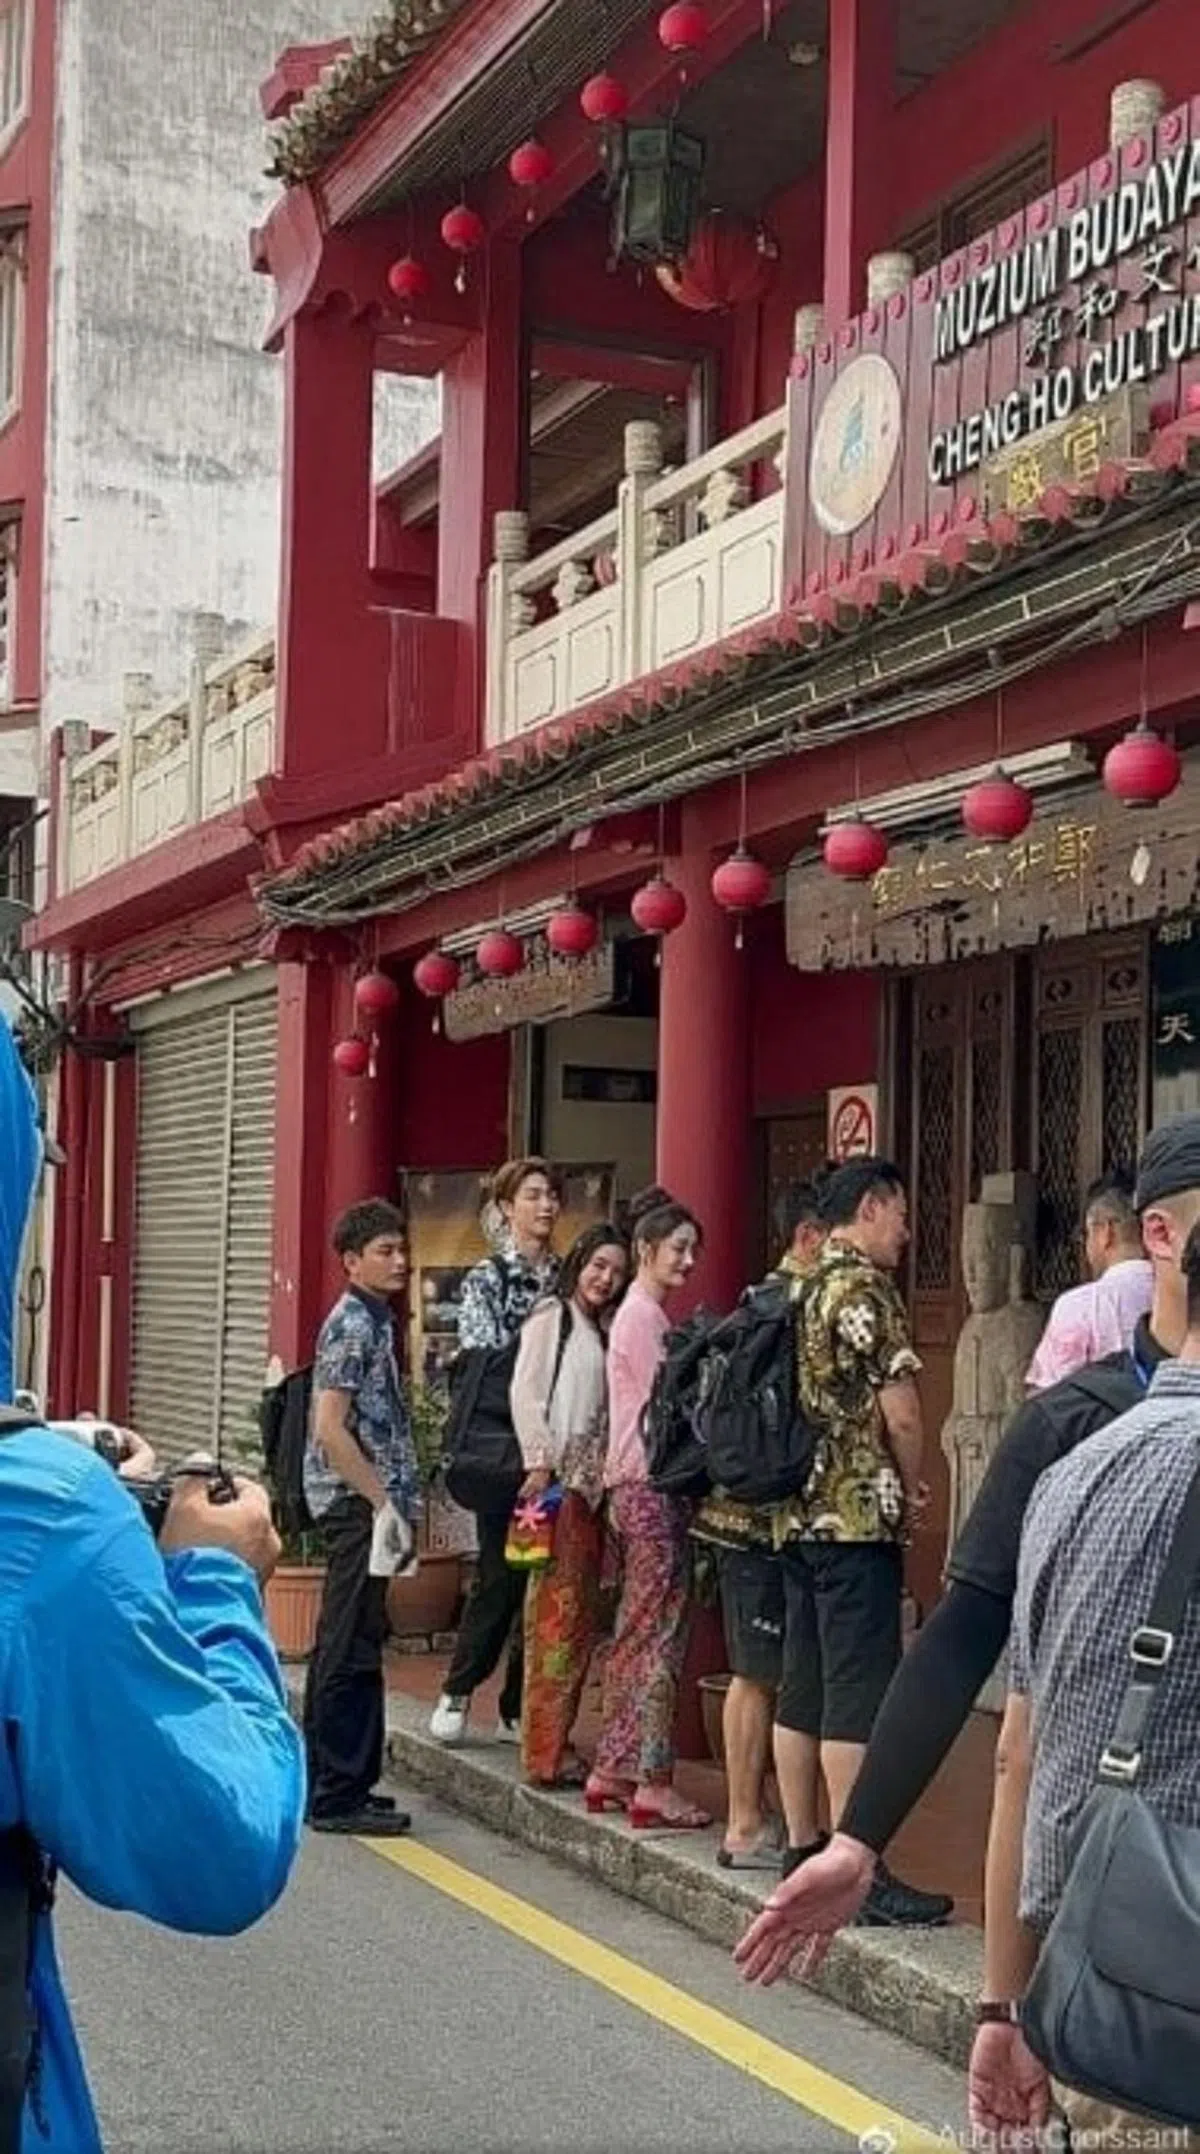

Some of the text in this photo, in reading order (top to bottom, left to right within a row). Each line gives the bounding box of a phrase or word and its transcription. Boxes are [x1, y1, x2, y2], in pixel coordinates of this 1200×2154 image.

[935, 226, 1059, 360] MUZIUM
[928, 391, 1020, 483] CHENG
[1028, 366, 1073, 430] HO
